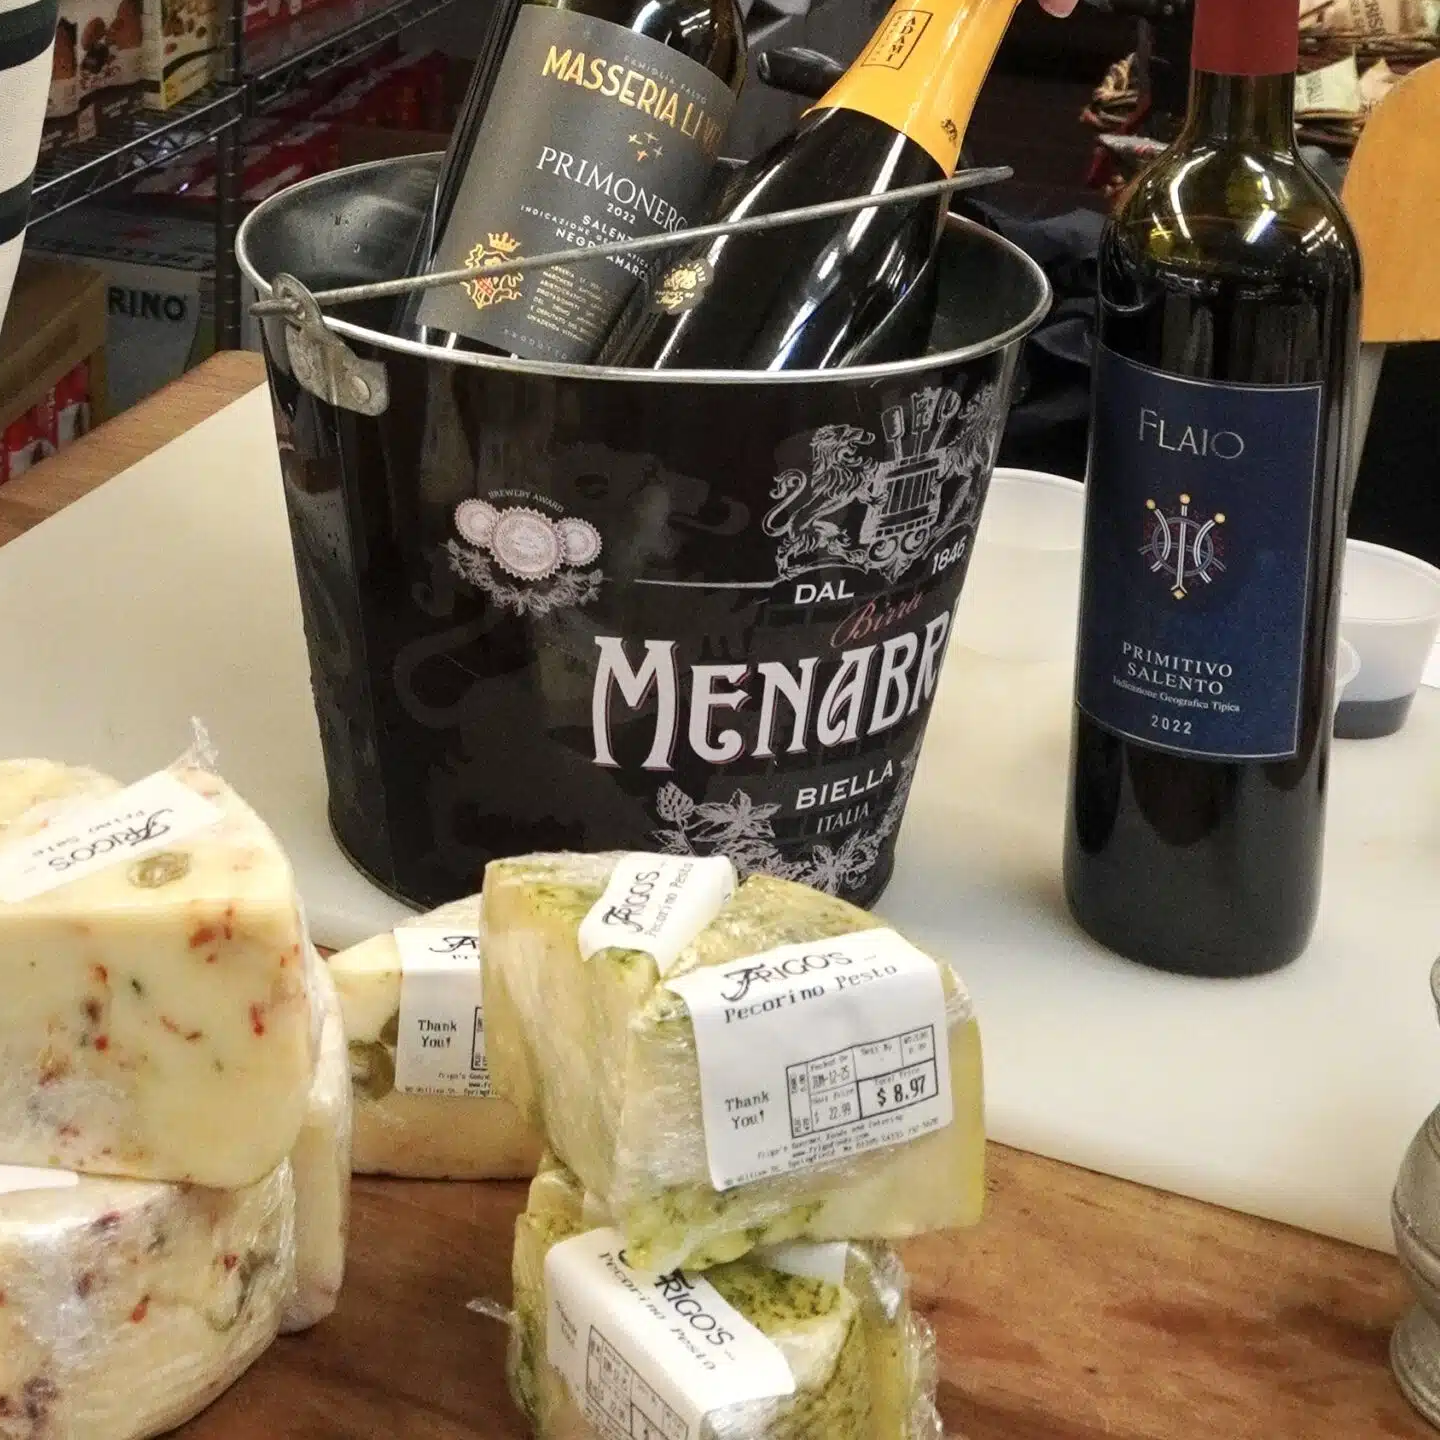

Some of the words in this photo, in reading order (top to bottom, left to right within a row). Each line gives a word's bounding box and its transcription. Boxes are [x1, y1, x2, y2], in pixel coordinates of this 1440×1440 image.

[885, 16, 916, 62] ADAMI
[541, 44, 679, 129] MASSERIA
[520, 205, 591, 236] INDICAZIONE
[607, 202, 637, 225] 2022
[1139, 407, 1245, 459] FLAIO
[794, 579, 855, 605] DAL
[829, 590, 924, 648] Birra
[1122, 640, 1233, 678] PRIMITIVO
[1127, 661, 1224, 696] SALENTO
[1159, 691, 1210, 710] Geografica
[1212, 700, 1241, 714] Tipica
[1151, 714, 1193, 735] 2022
[794, 759, 895, 811] BIELLA
[816, 803, 871, 835] ITALIA
[721, 951, 853, 1002] FRIGO'S
[724, 985, 825, 1023] Pecorino
[834, 963, 897, 990] Pesto
[417, 1018, 458, 1034] Thank
[421, 1035, 452, 1050] You!
[724, 1090, 771, 1113] Thank
[876, 1086, 887, 1108] $
[893, 1074, 927, 1104] 8.97
[731, 1109, 765, 1131] You!
